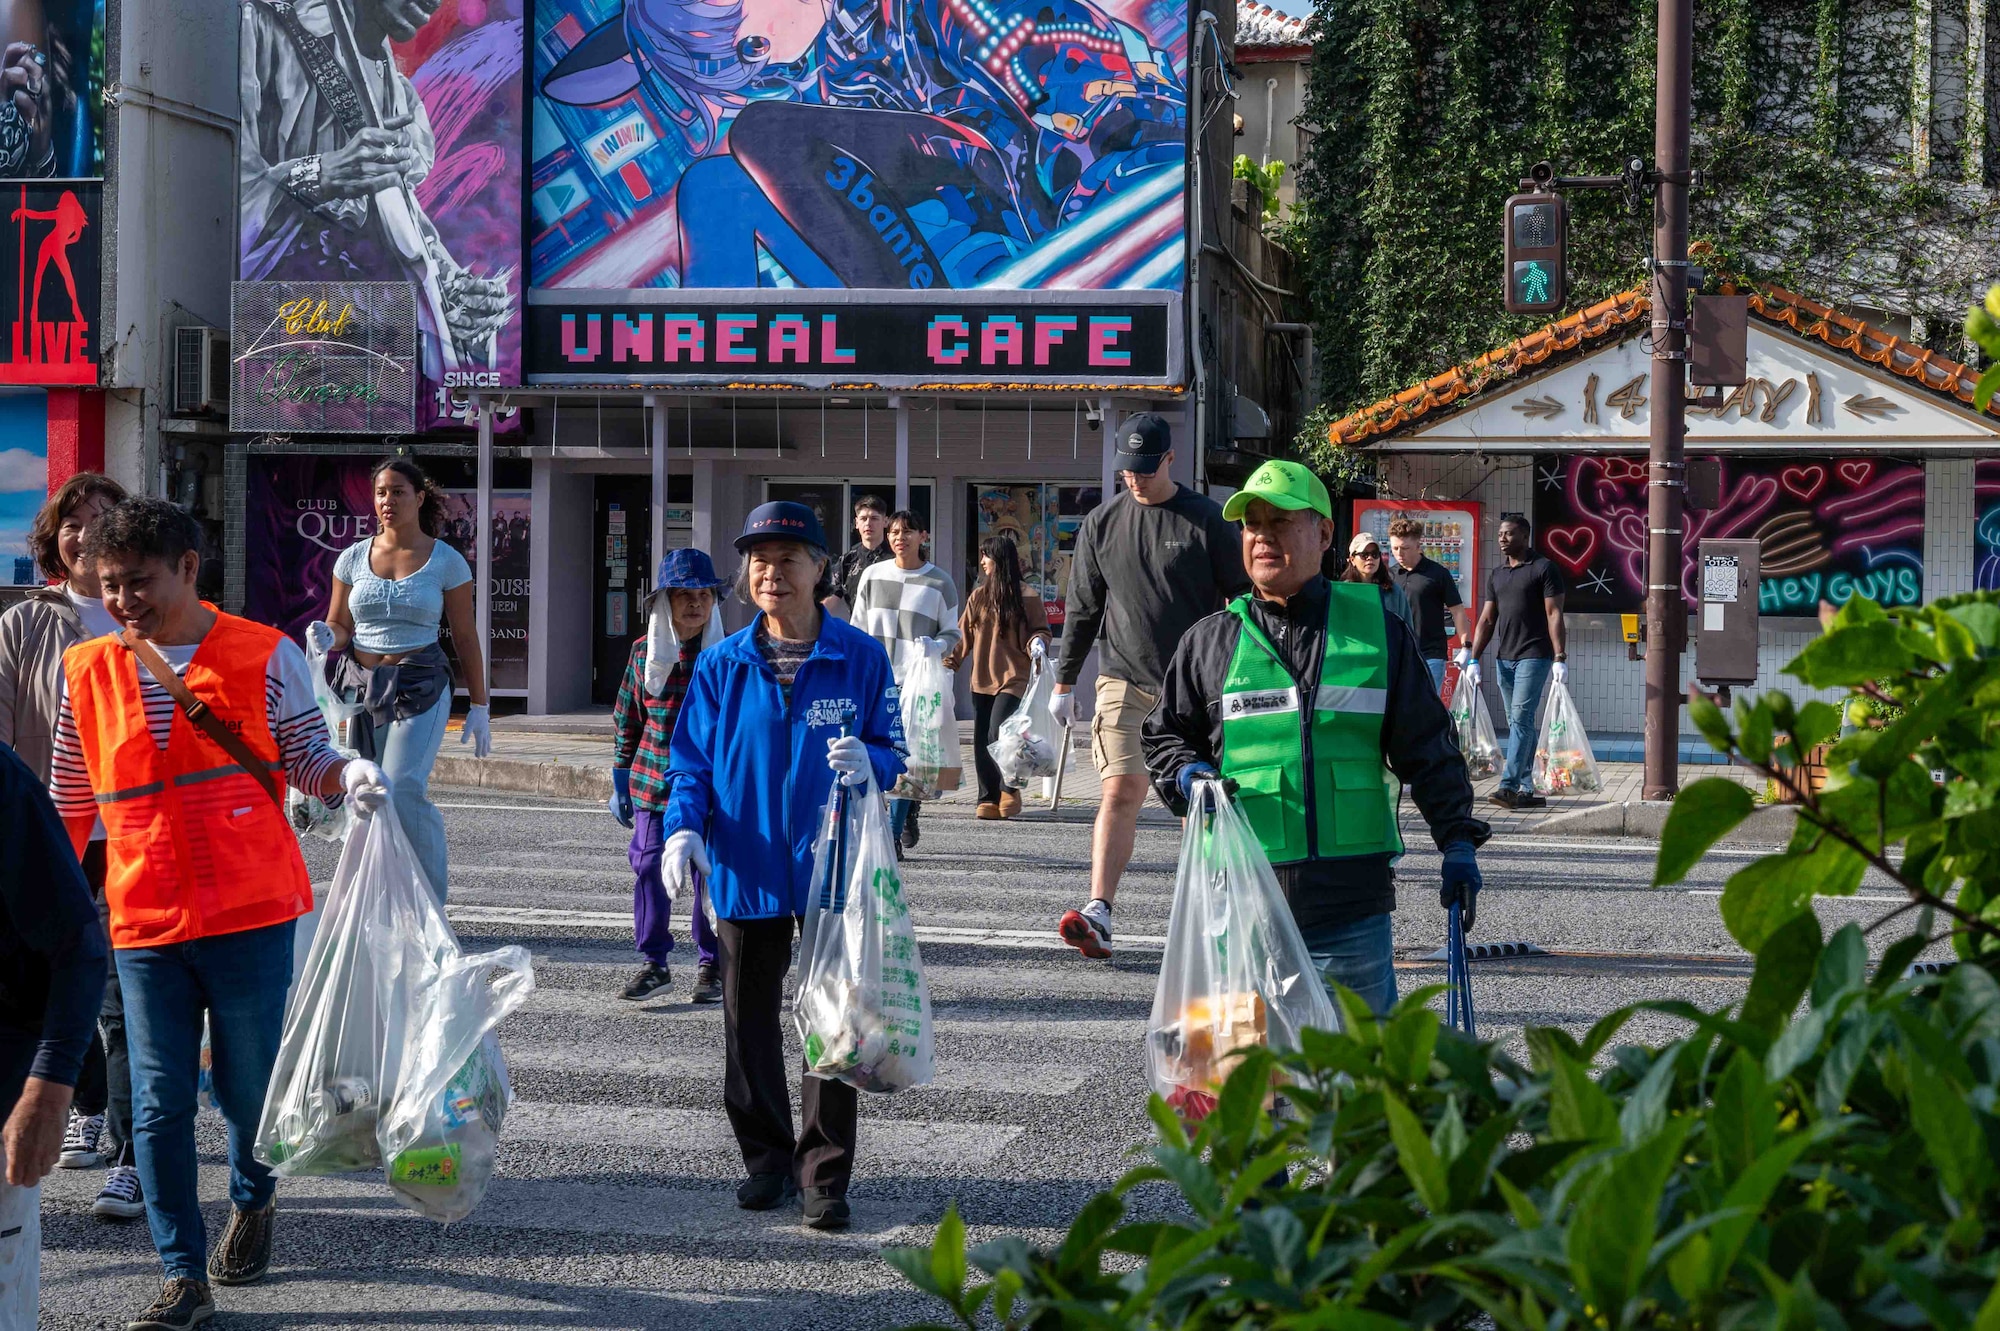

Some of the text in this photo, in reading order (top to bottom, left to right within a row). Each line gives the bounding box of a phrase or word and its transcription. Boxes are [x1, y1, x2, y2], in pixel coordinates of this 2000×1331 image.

[279, 297, 352, 337] Club
[12, 321, 88, 365] LIVE
[561, 314, 1132, 366] UNREAL CAFE
[256, 348, 381, 406] Queen
[443, 371, 501, 388] SINCE
[296, 499, 338, 511] CLUB
[1708, 559, 1735, 567] 0120
[1705, 567, 1737, 581] 182
[1704, 579, 1737, 593] 333
[1828, 568, 1916, 604] GUYS
[1227, 676, 1251, 687] FILA
[812, 698, 852, 710] STAFF
